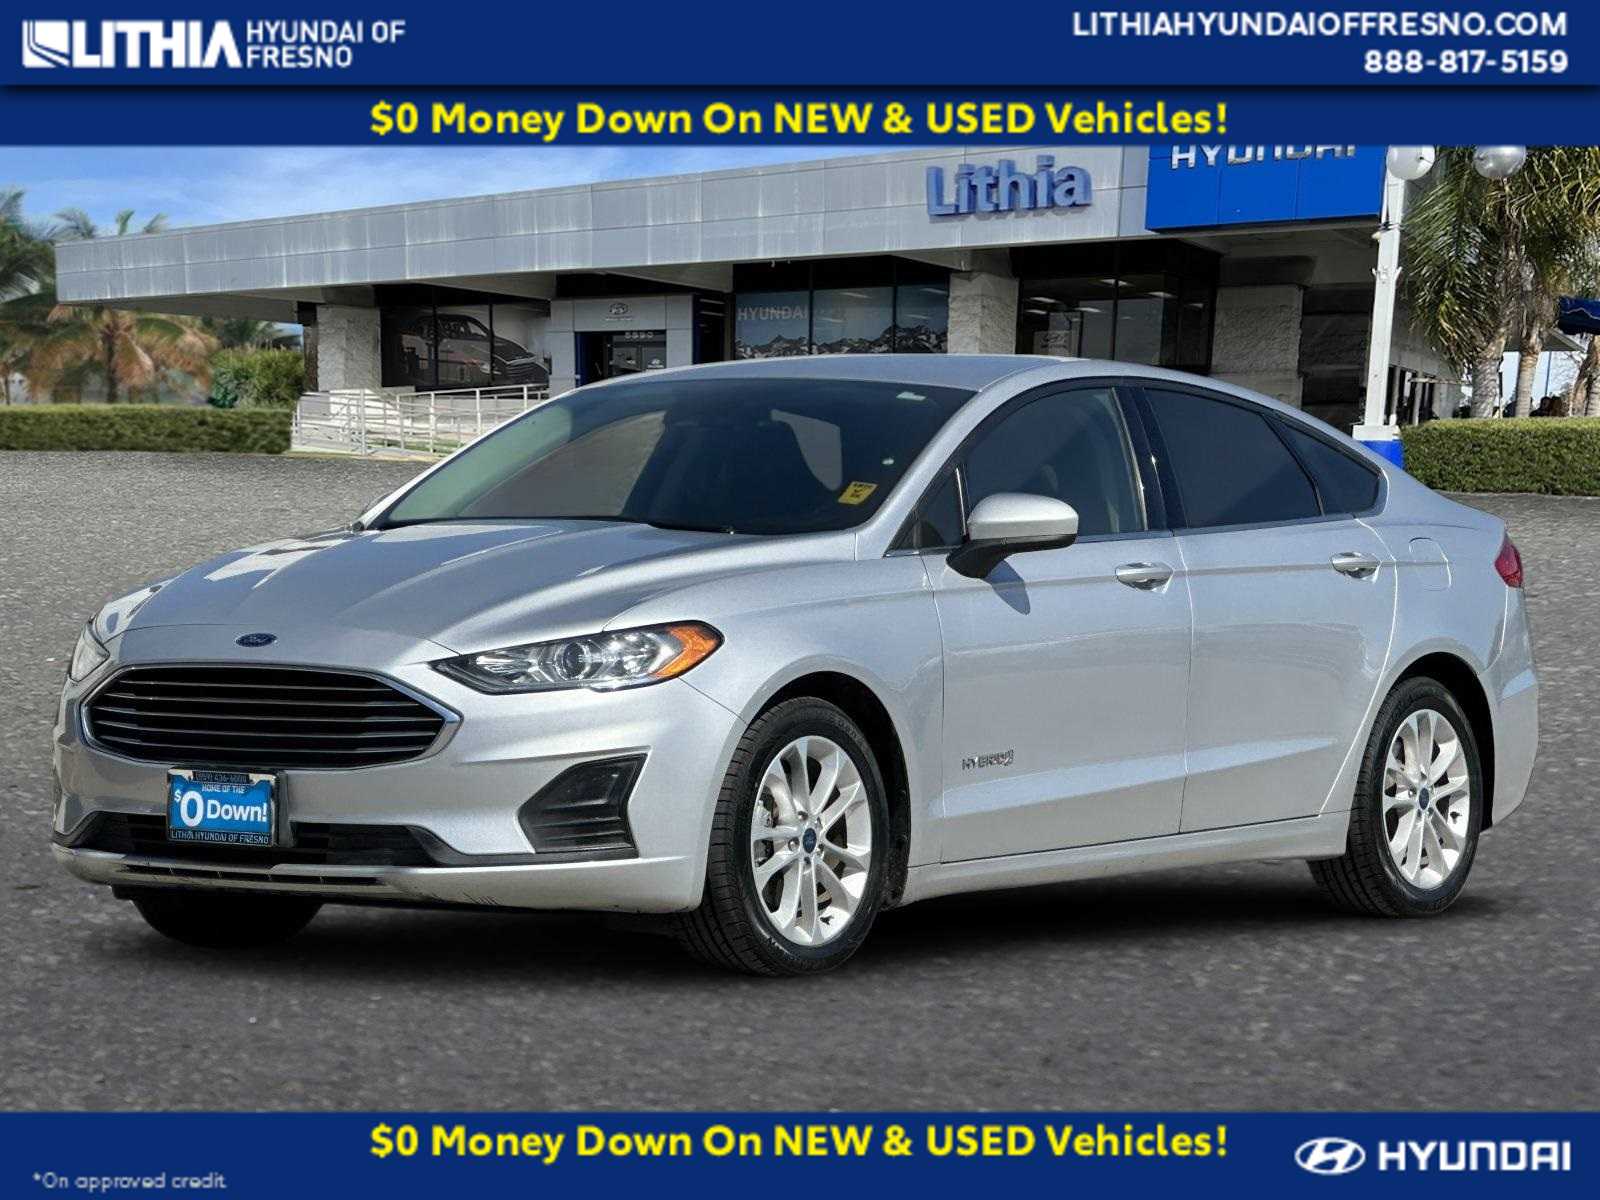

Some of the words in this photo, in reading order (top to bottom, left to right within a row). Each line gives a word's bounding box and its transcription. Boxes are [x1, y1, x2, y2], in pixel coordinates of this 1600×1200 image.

[925, 154, 1092, 215] Lithia
[737, 304, 809, 321] HYUNDAI
[202, 784, 221, 792] HOME
[222, 785, 231, 793] OF
[207, 799, 268, 822] Down!
[195, 831, 227, 841] HYUNDAI
[228, 833, 238, 842] OF
[239, 834, 269, 845] FRESNO
